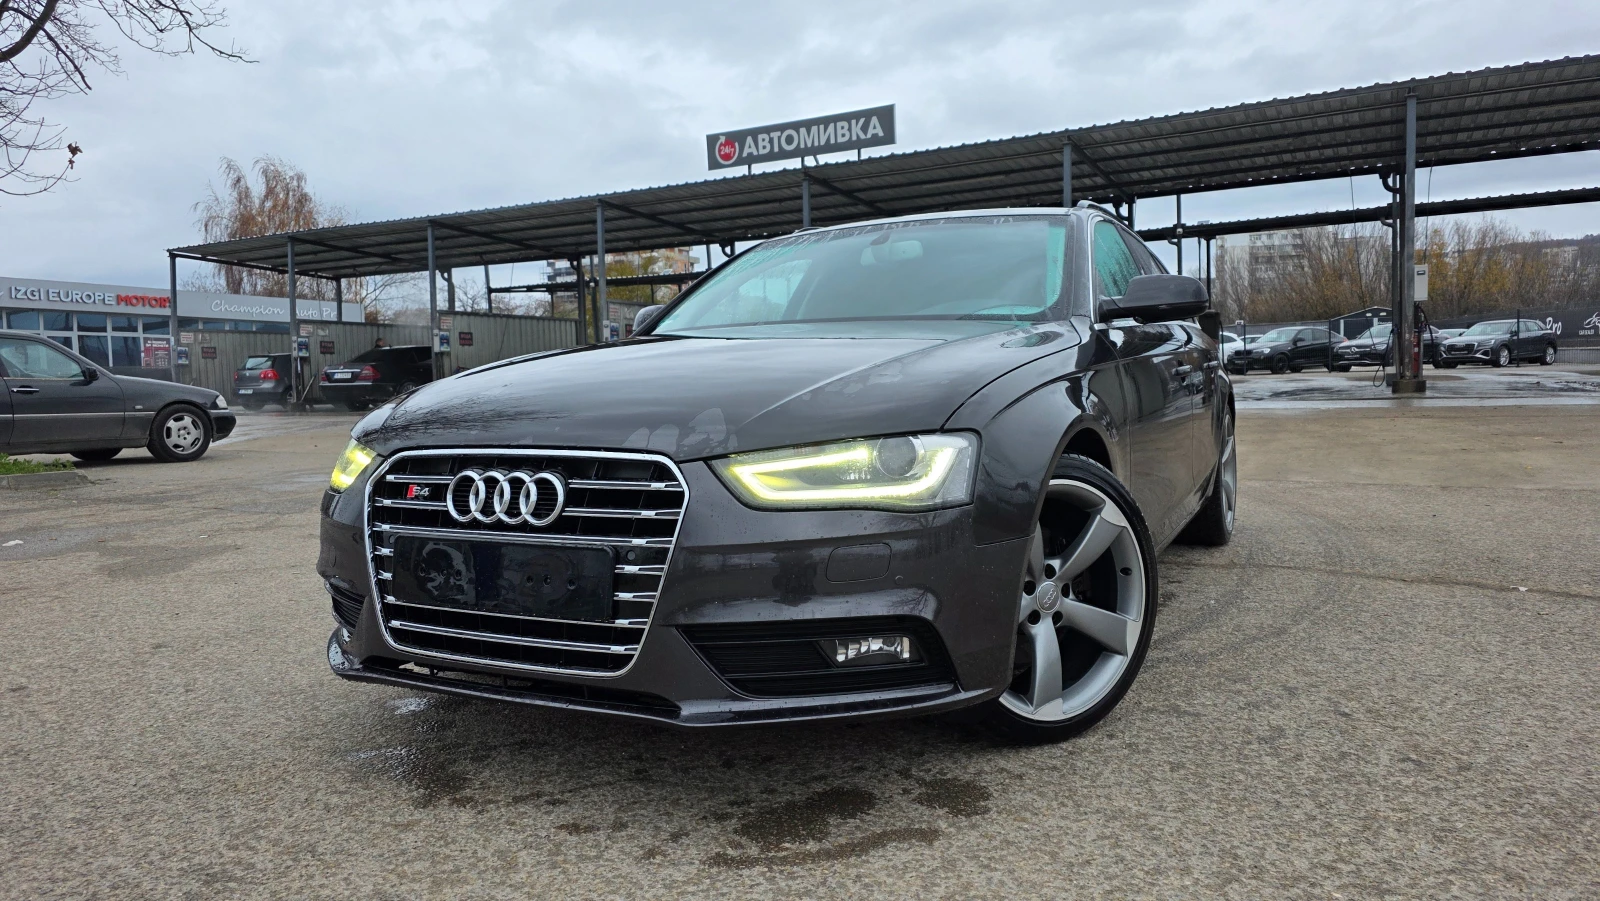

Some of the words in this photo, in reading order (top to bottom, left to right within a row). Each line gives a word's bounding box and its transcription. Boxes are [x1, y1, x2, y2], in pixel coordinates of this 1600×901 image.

[720, 146, 735, 157] 24/7
[742, 116, 884, 157] АВТОМИВКА
[10, 285, 44, 300] IZGI
[48, 288, 116, 306] EUROPE
[116, 293, 171, 309] MOTOR
[211, 299, 284, 317] Champion
[322, 307, 338, 319] Pr
[412, 486, 430, 496] S4
